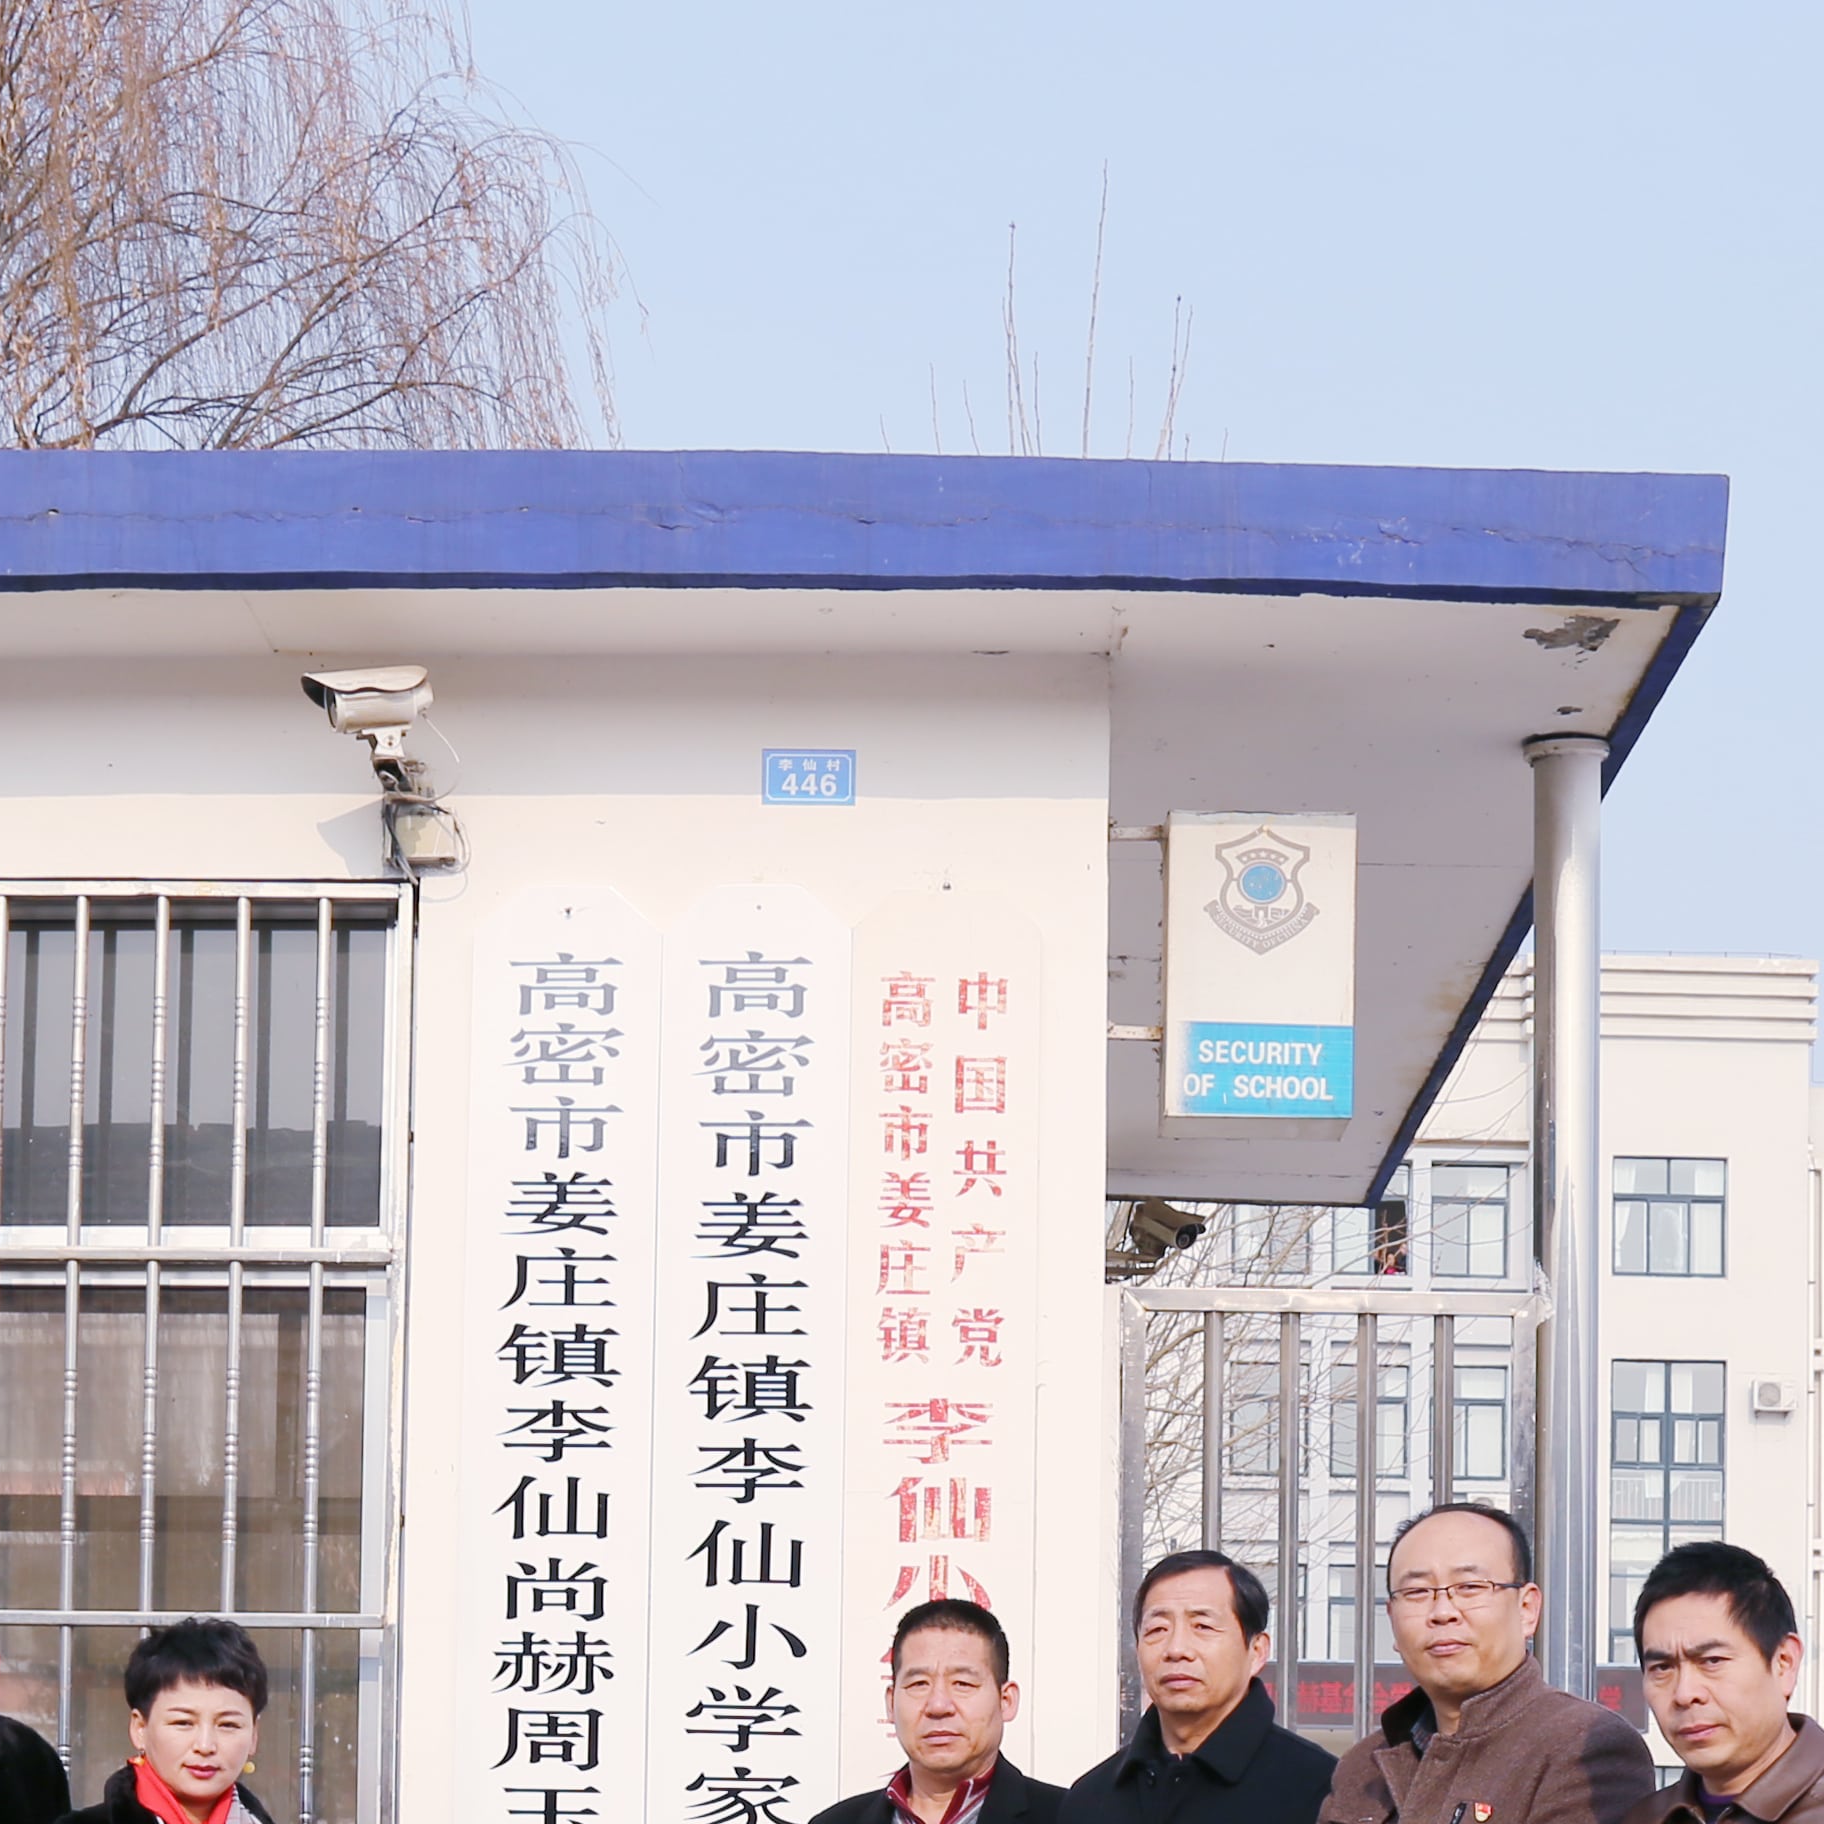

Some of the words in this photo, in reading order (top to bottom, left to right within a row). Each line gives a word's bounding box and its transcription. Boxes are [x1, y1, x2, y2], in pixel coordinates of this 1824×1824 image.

[781, 773, 837, 796] 446
[1183, 1073, 1215, 1097] OF
[1233, 1075, 1334, 1101] SCHOOL
[1198, 1039, 1323, 1066] SECURITY
[876, 971, 936, 1364] 高密市姜庄镇
[950, 971, 1009, 1367] 中国共产党
[879, 1398, 994, 1777] 李仙小
